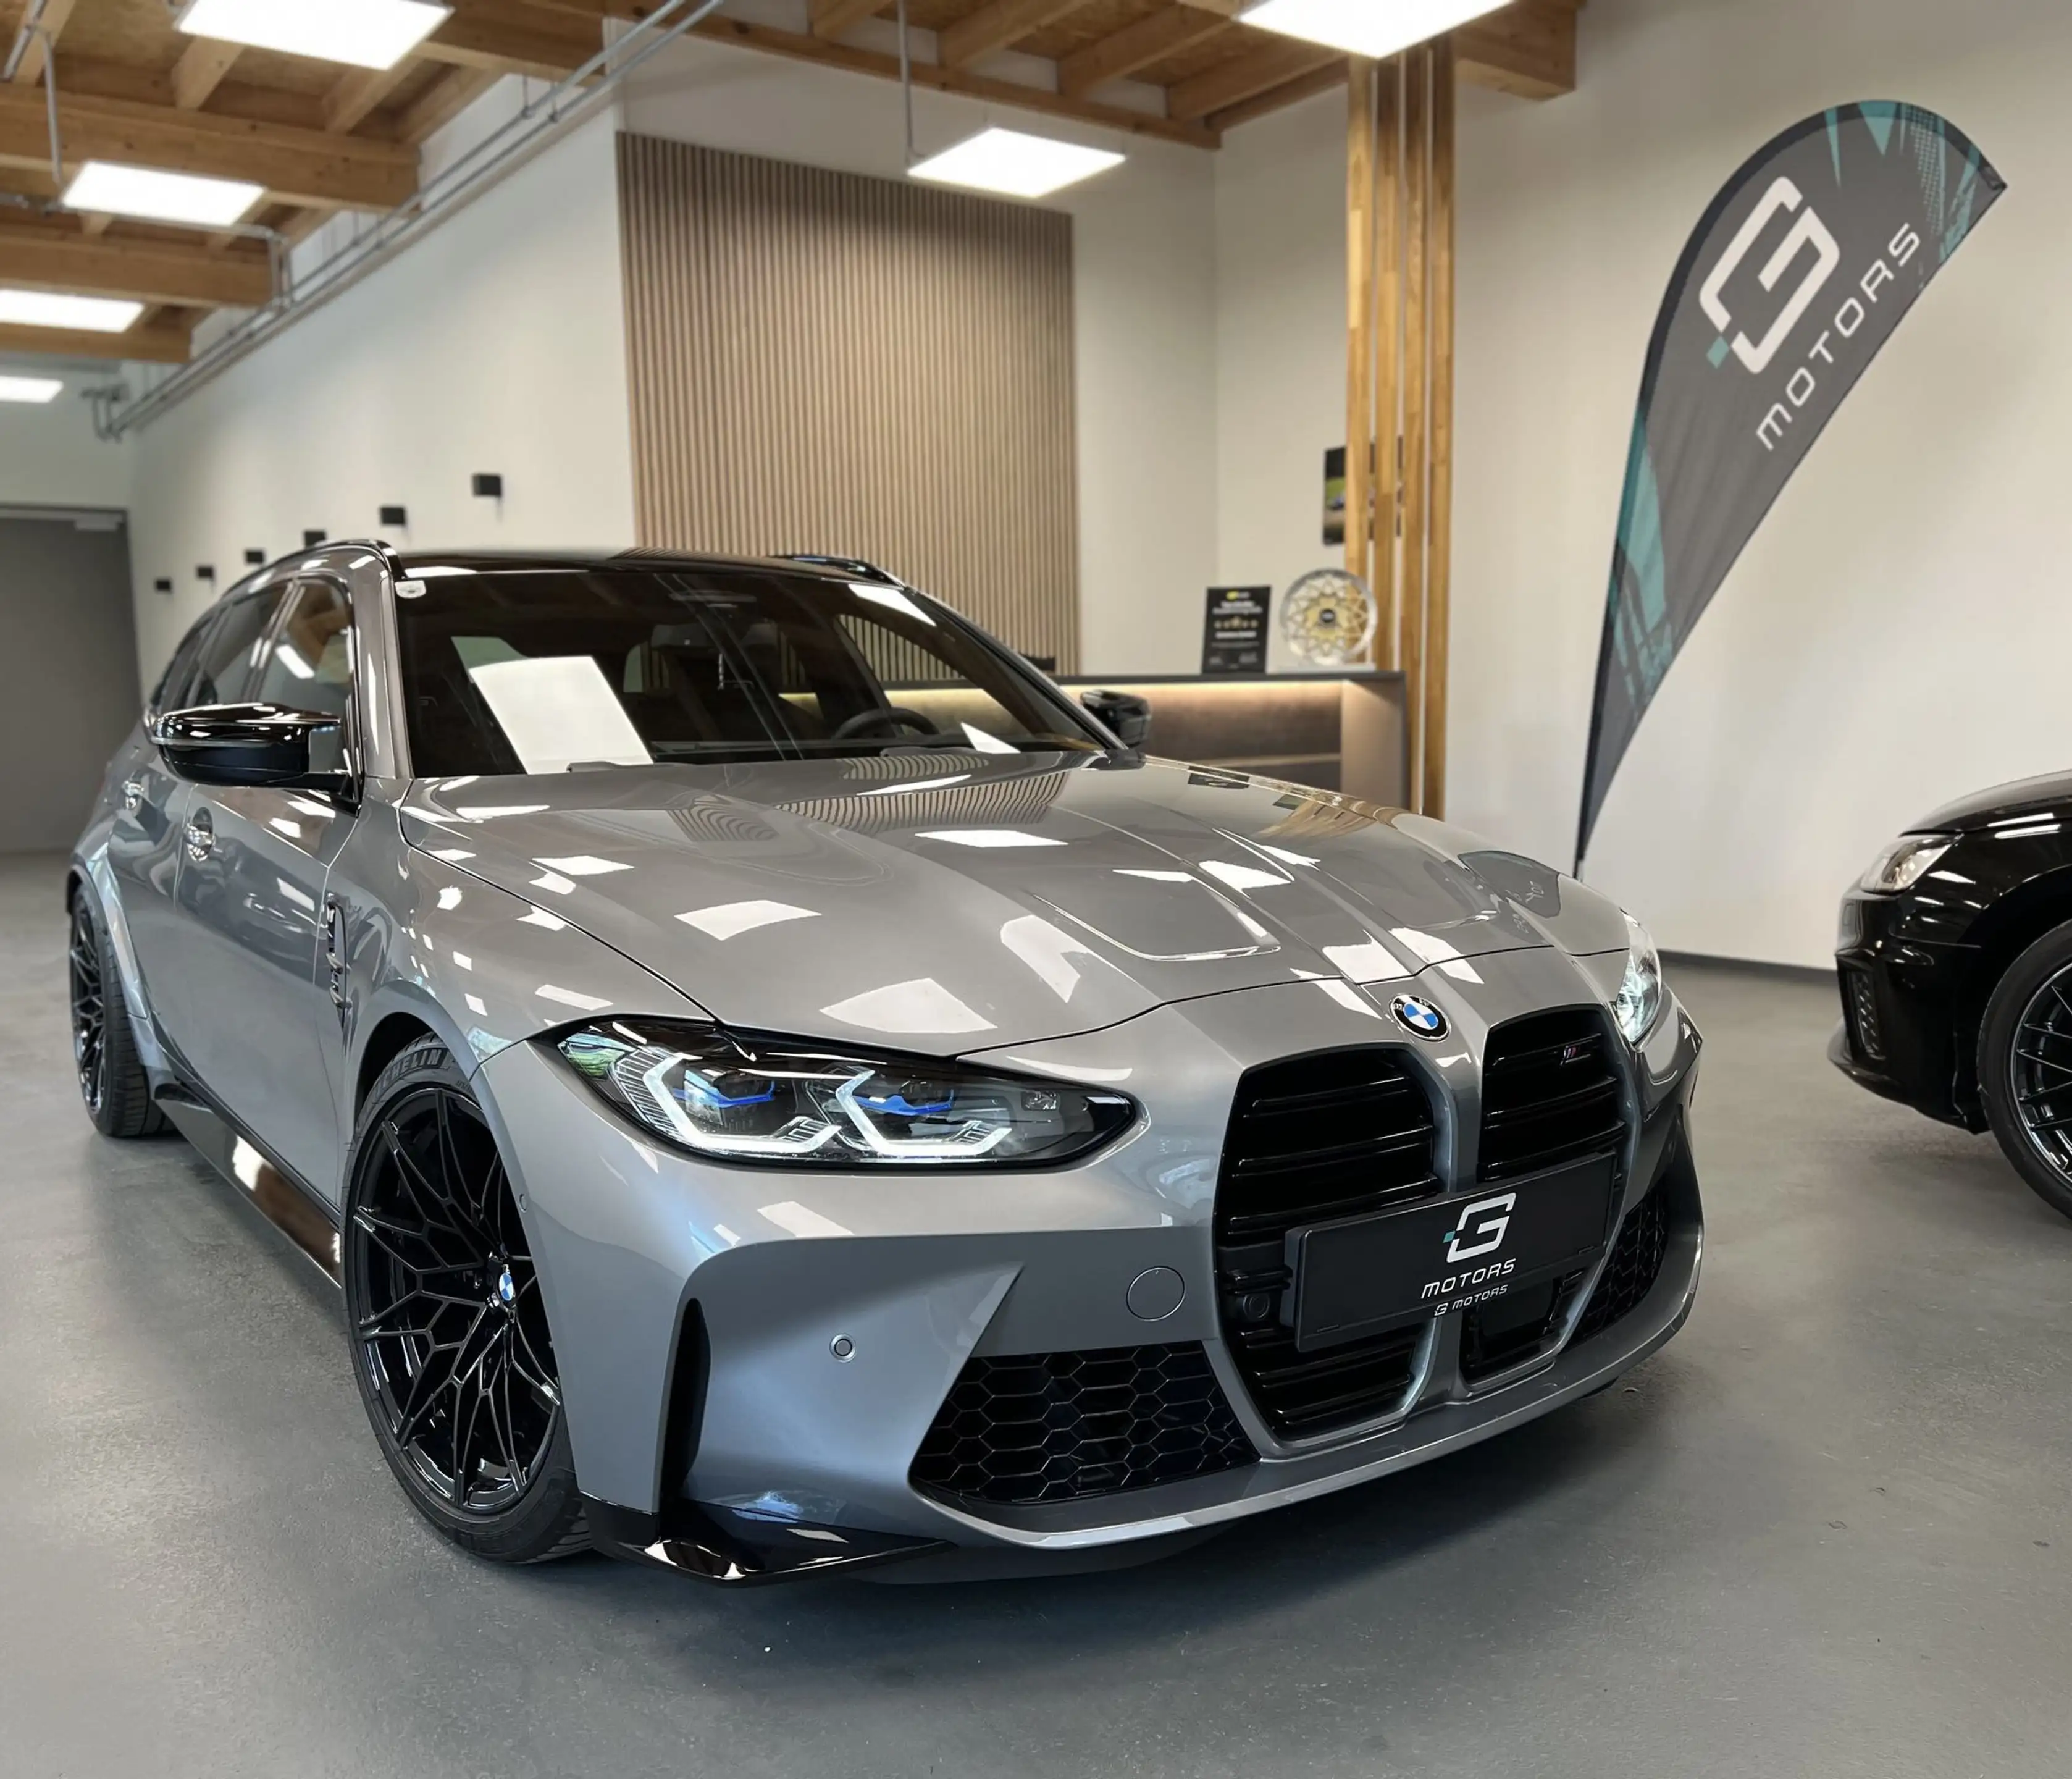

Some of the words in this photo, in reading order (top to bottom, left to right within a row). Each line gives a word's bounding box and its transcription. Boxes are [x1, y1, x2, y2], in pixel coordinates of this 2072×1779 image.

[1755, 222, 1921, 451] MOTORS
[372, 1049, 443, 1100] ICHELIN
[1421, 1258, 1517, 1299] MOTORS
[1452, 1284, 1509, 1310] MOTORS
